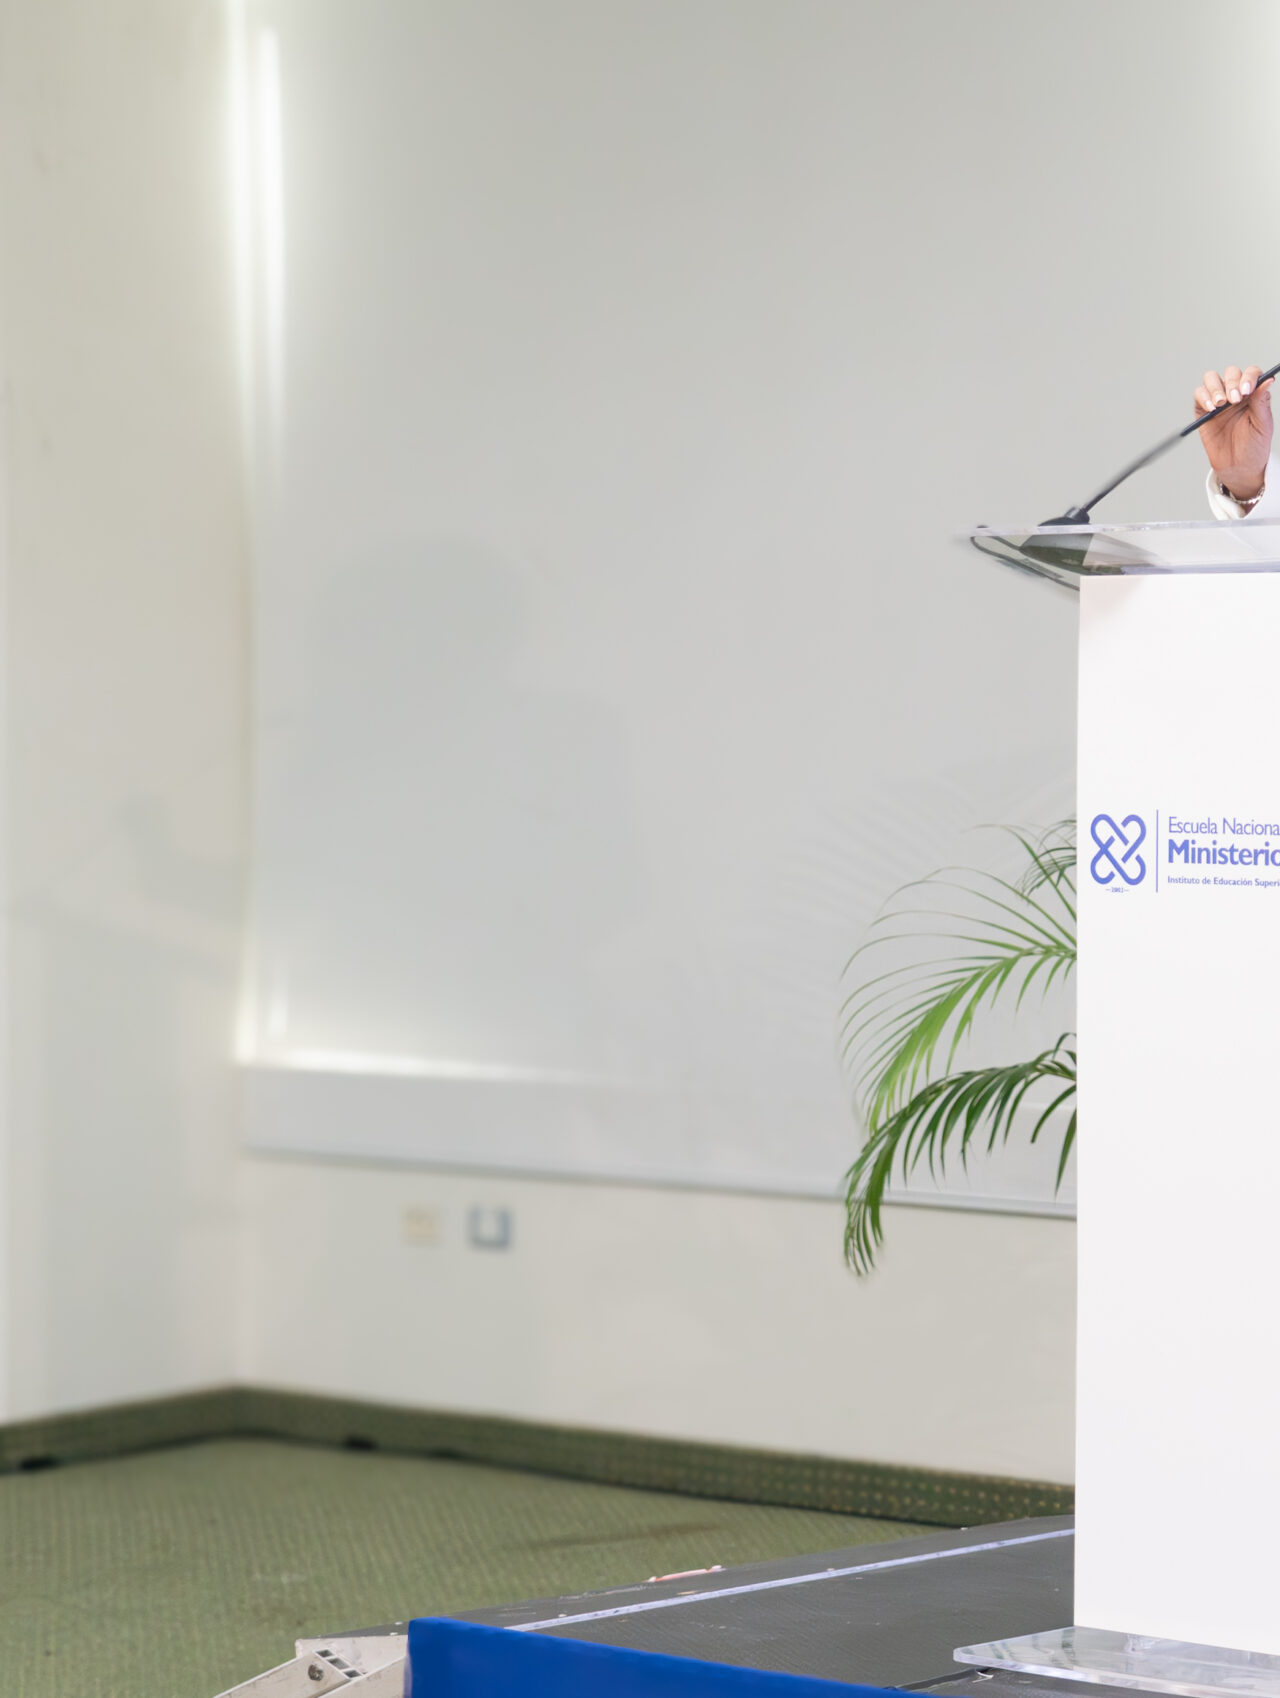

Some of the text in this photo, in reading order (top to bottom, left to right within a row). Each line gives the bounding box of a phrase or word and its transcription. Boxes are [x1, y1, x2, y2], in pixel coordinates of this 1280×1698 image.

[1168, 816, 1218, 834] Escuela
[1167, 875, 1200, 885] Instituto
[1201, 877, 1211, 886] de
[1213, 876, 1253, 887] Educación
